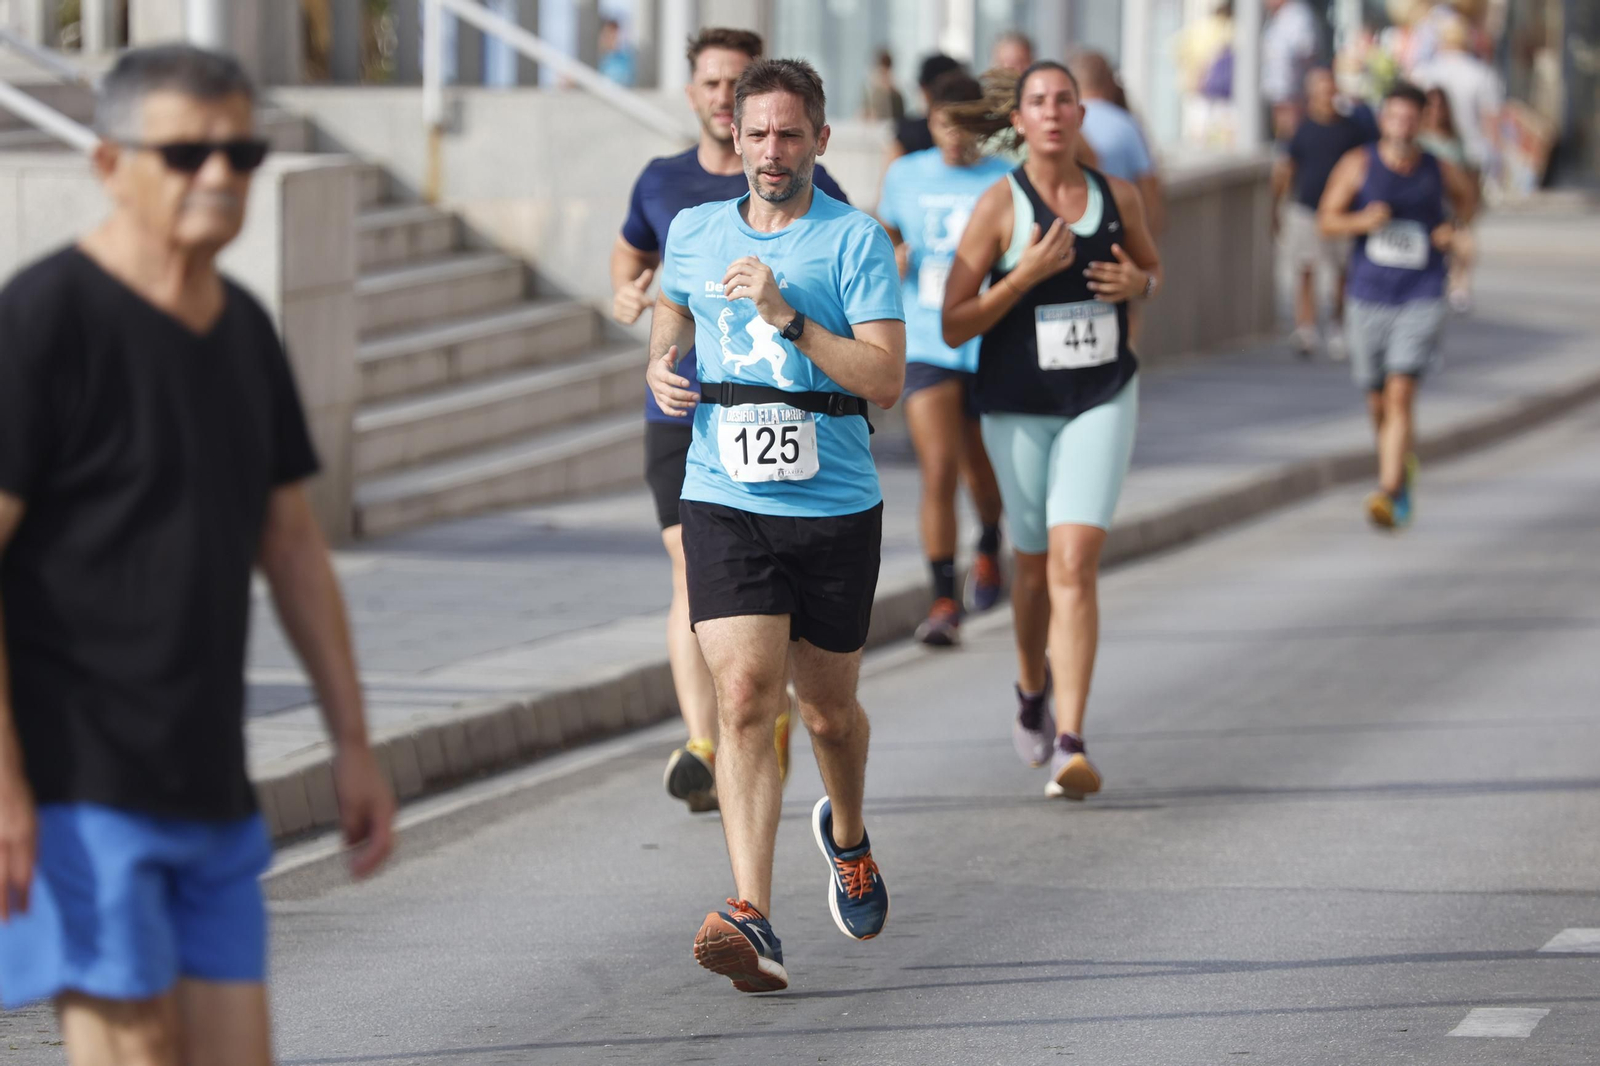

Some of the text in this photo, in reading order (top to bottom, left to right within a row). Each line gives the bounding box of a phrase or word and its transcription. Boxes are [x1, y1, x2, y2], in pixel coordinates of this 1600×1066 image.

[1064, 319, 1098, 352] 44
[757, 407, 780, 426] ELA
[734, 425, 800, 466] 125
